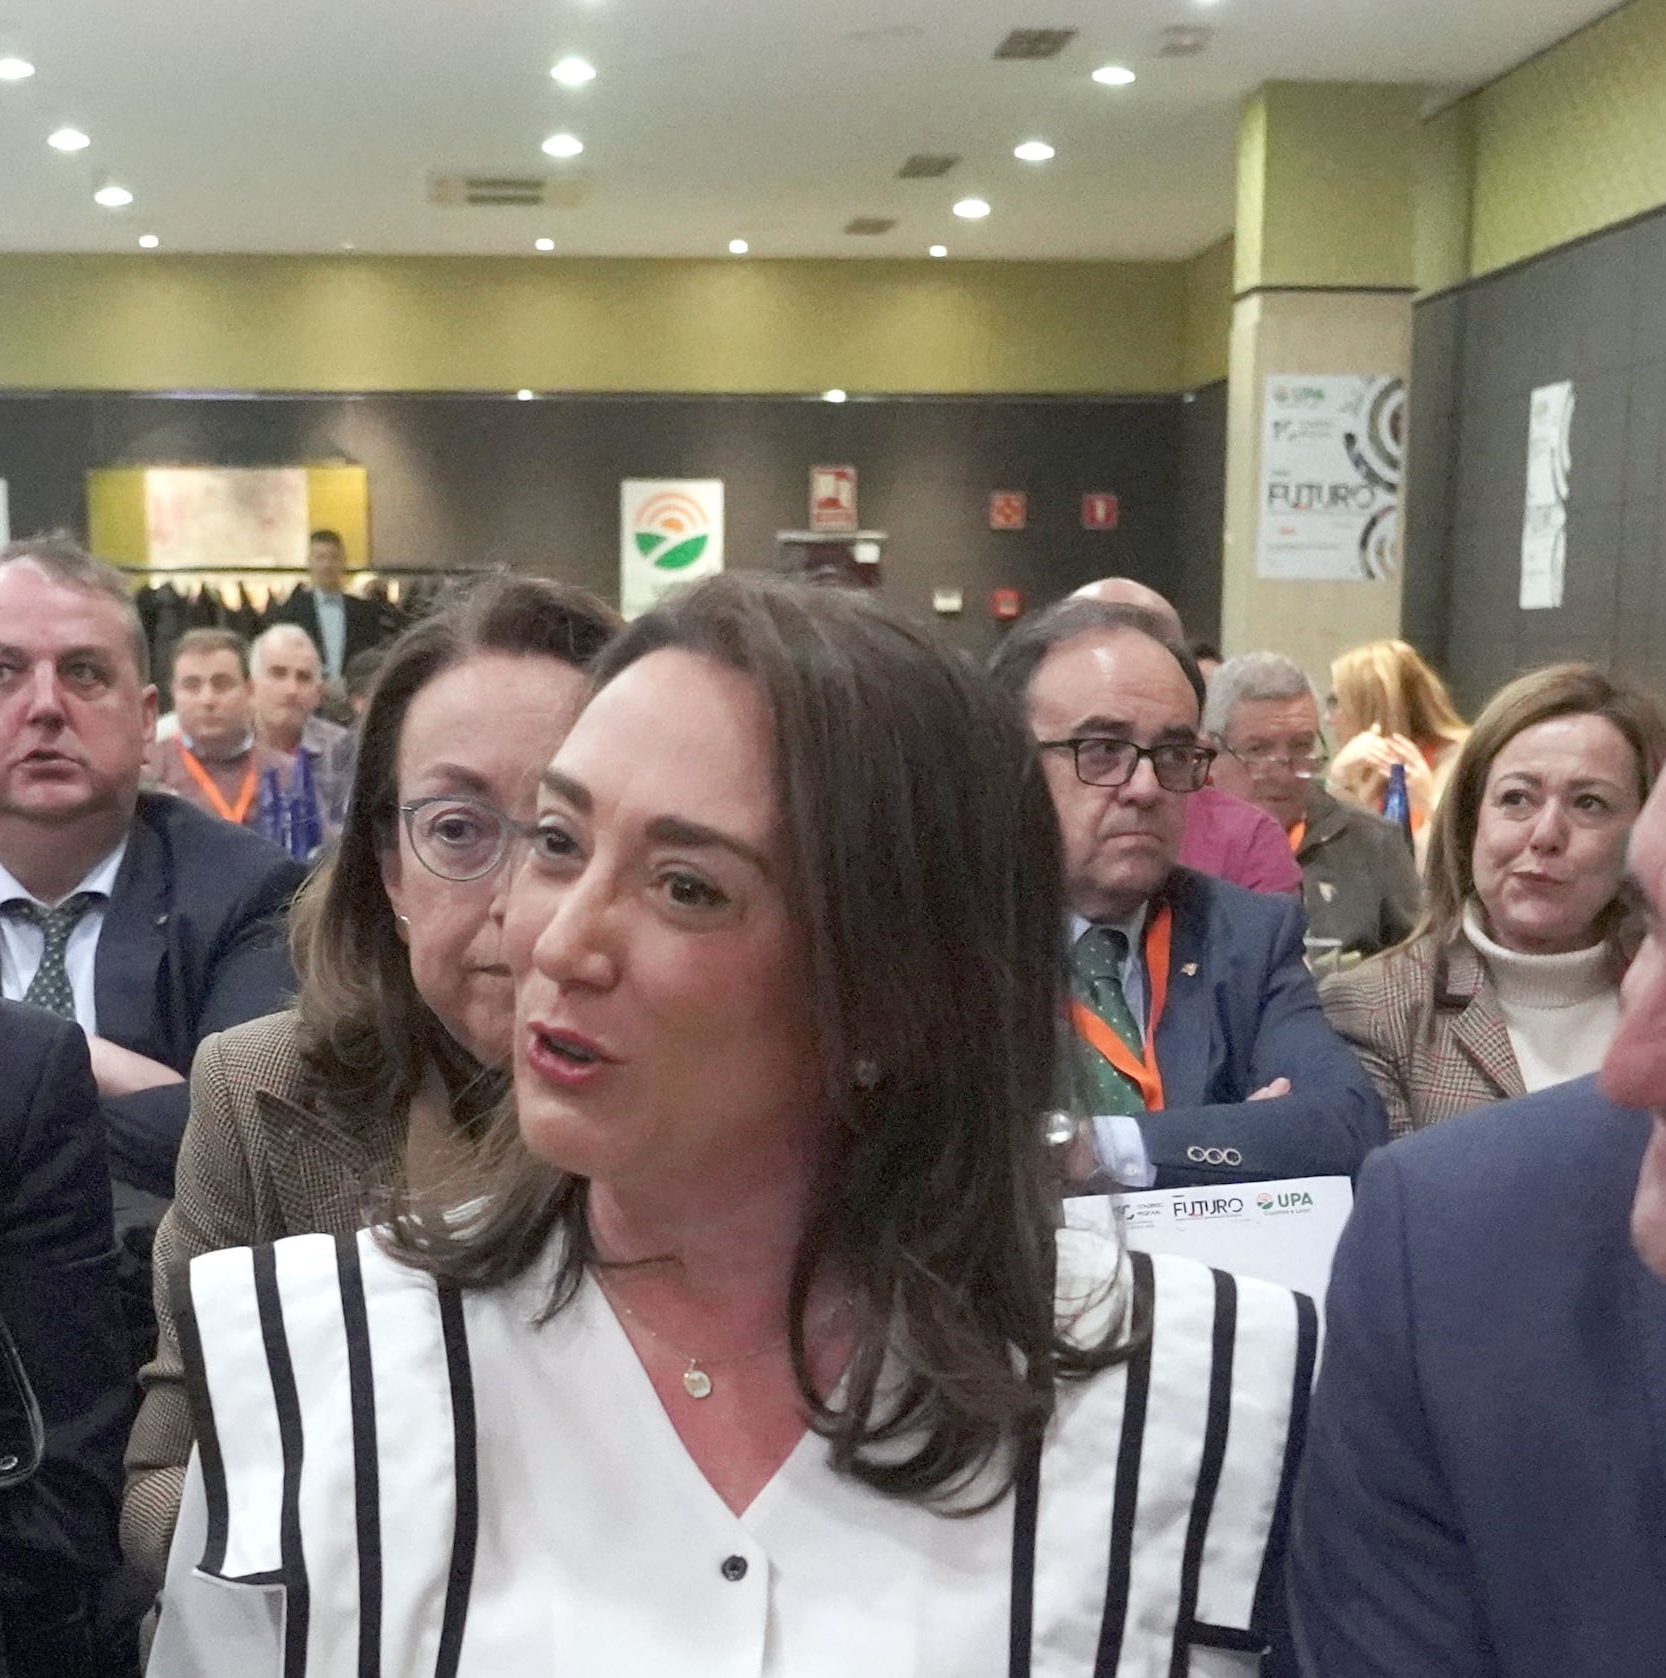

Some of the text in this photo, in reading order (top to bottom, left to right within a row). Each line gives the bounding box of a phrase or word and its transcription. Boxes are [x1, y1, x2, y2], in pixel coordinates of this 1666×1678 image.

[1268, 482, 1375, 508] FUTURO
[1173, 1198, 1244, 1217] FUTURO
[1277, 1192, 1314, 1208] UPA
